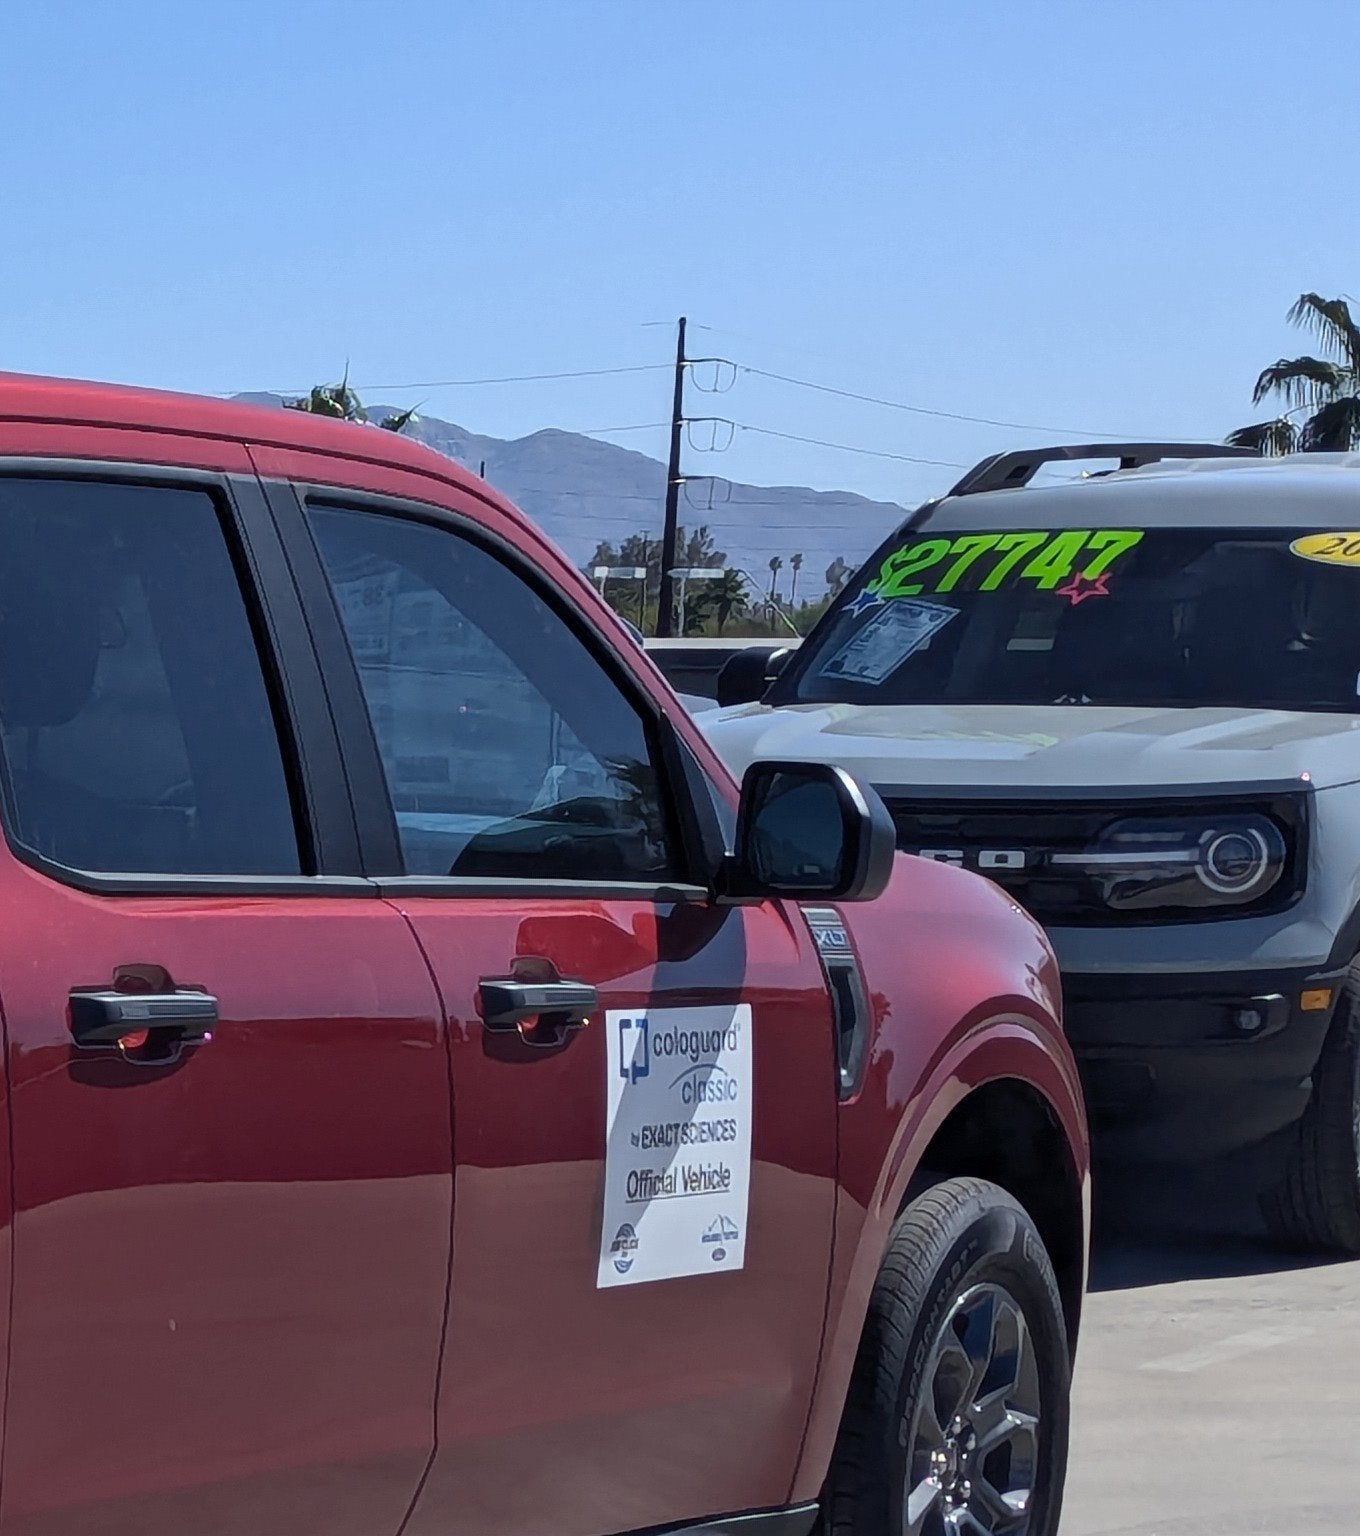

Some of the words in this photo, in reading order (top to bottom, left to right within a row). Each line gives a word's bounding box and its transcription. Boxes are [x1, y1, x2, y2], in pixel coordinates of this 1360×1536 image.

[868, 531, 1146, 598] $27747
[653, 1024, 738, 1063] cologuard
[682, 1073, 737, 1104] classic
[626, 1169, 677, 1199] Official
[681, 1162, 731, 1192] Vehicle
